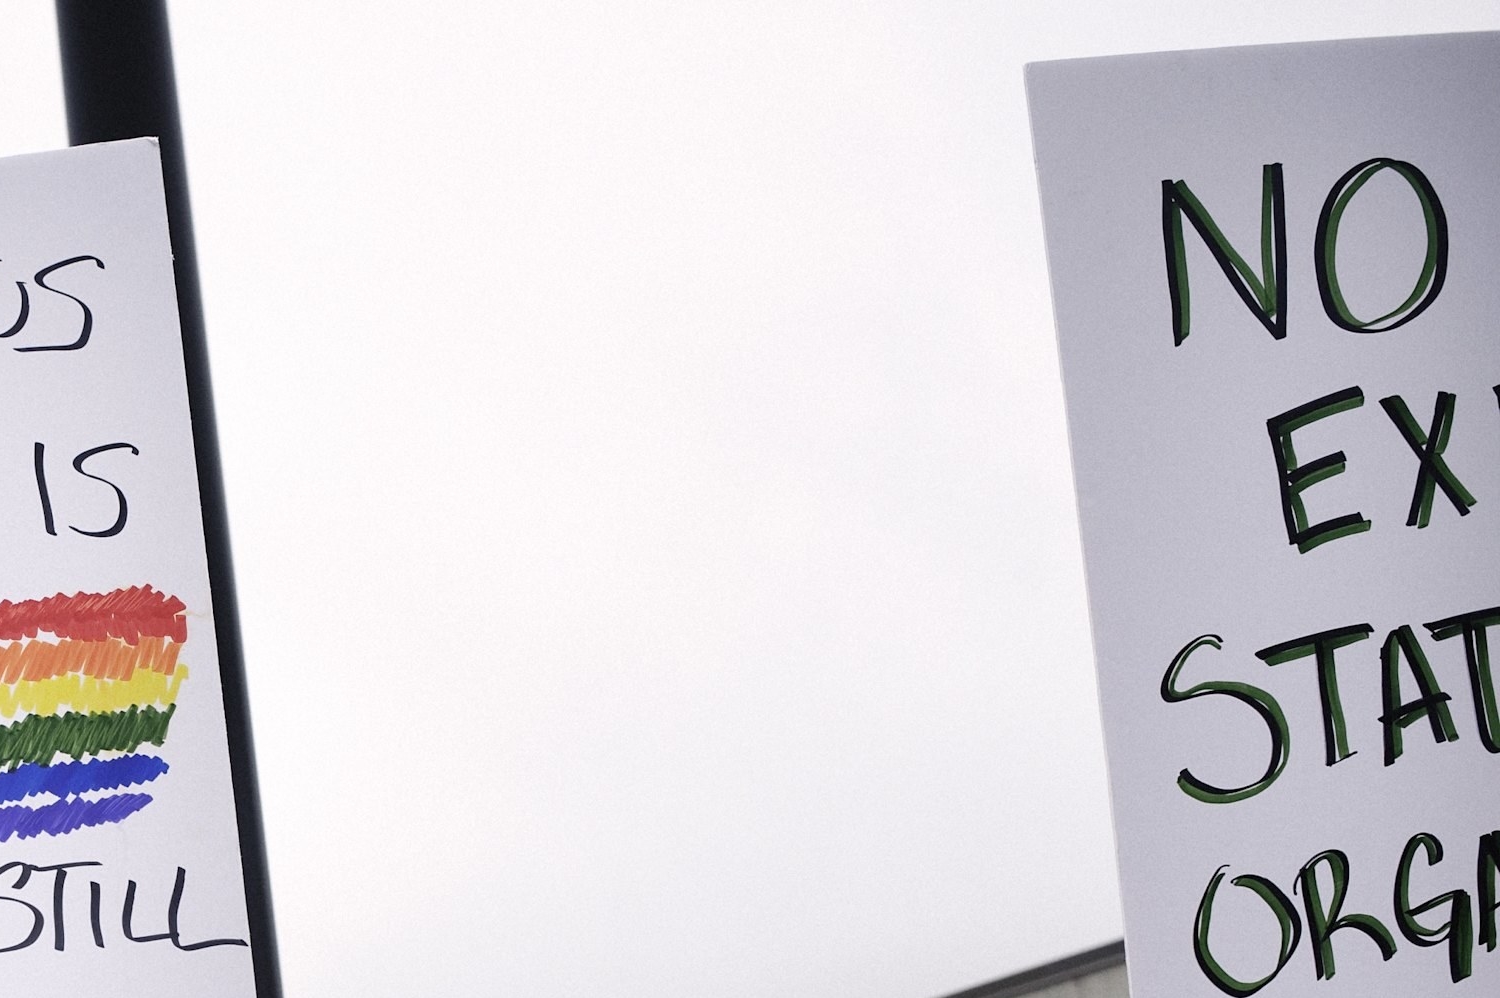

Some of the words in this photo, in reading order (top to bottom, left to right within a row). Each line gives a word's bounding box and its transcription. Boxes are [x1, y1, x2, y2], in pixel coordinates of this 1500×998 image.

[1162, 157, 1449, 346] NO
[34, 441, 140, 538] IS
[1267, 384, 1500, 555] EX
